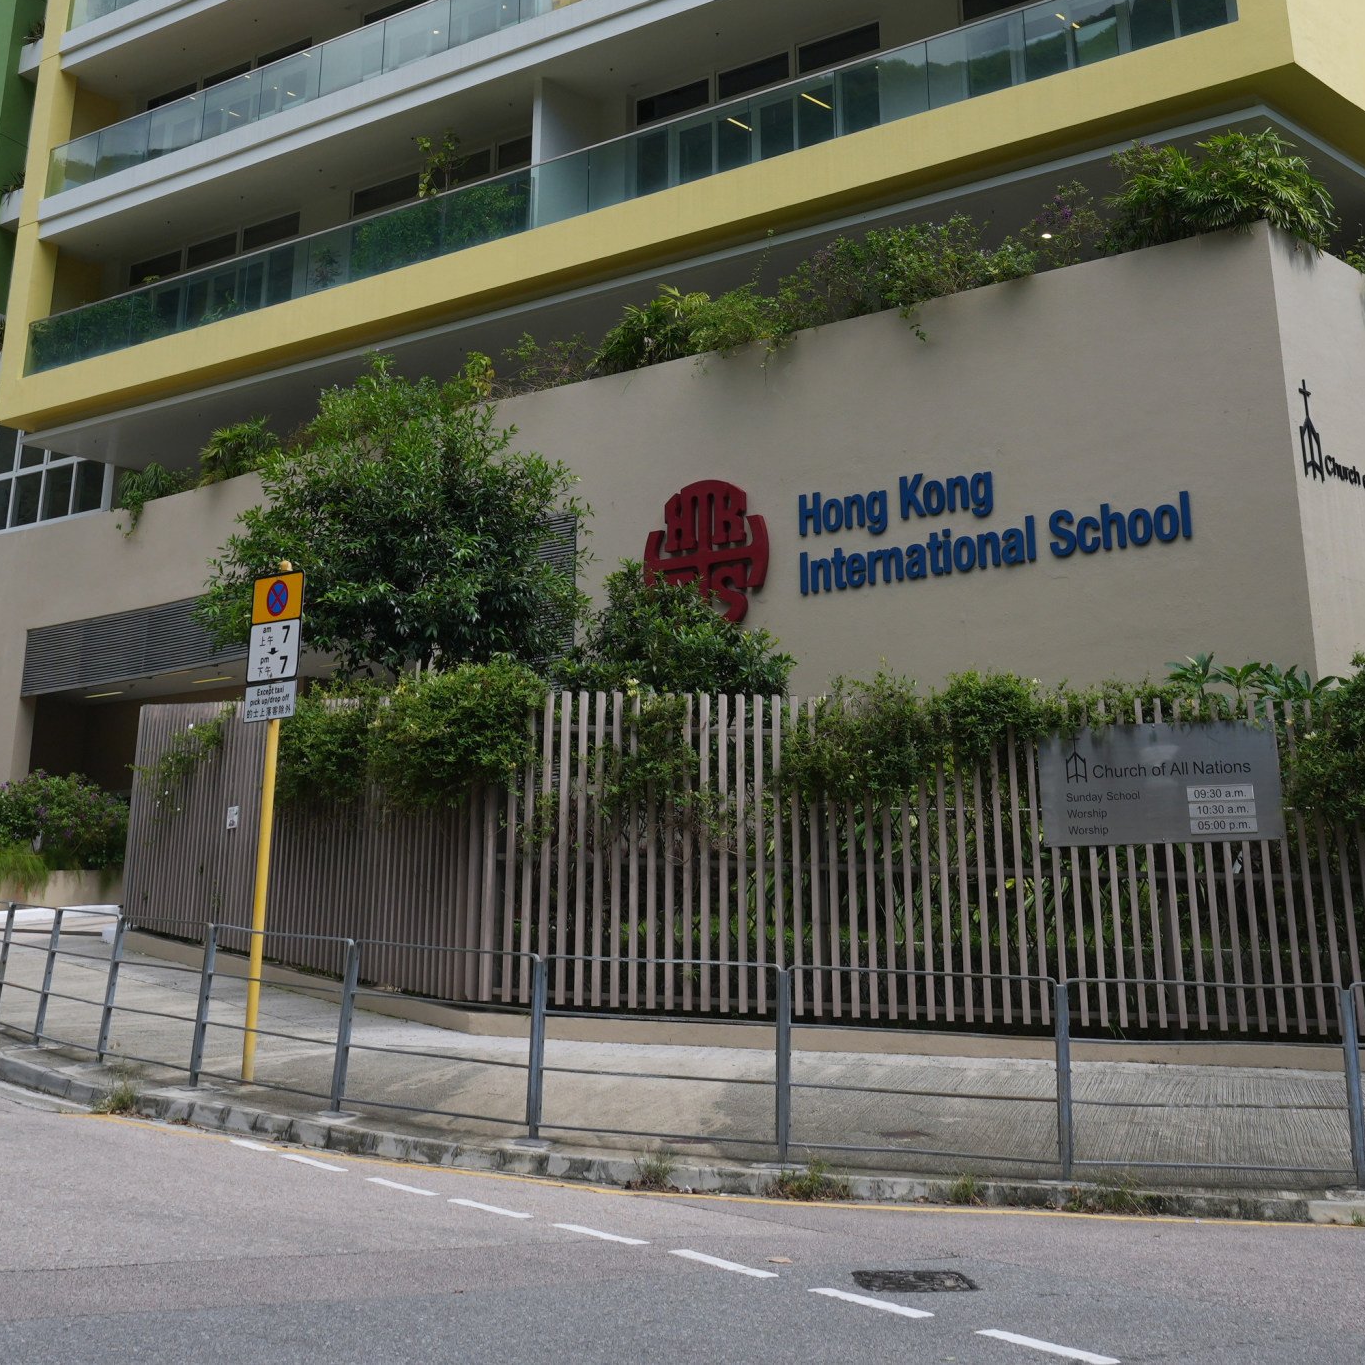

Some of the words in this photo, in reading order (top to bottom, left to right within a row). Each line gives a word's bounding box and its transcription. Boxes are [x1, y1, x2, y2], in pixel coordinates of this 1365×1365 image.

[1324, 455, 1361, 486] Church
[798, 491, 889, 537] Hong
[898, 471, 994, 520] Kong
[799, 515, 1037, 596] International
[1048, 490, 1192, 557] School
[259, 636, 273, 646] 上午
[263, 626, 272, 634] am
[282, 625, 290, 643] 7
[257, 666, 272, 677] 下午
[260, 657, 270, 665] pm
[279, 655, 288, 674] 7
[256, 687, 274, 696] Except
[275, 685, 285, 694] taxi
[250, 698, 261, 707] pick
[262, 695, 281, 705] up/drop
[282, 693, 290, 702] off
[246, 704, 291, 718] 的士上落客除外
[1092, 763, 1147, 778] Church
[1151, 762, 1166, 776] of
[1170, 761, 1189, 776] All
[1192, 760, 1252, 775] Nations
[1066, 792, 1103, 803] Sunday
[1106, 791, 1141, 801] School
[1193, 788, 1222, 799] 09:30
[1225, 789, 1247, 798] a.m.
[1067, 808, 1108, 819] Worship
[1197, 804, 1225, 815] 10:30
[1227, 805, 1249, 814] a.m.
[1068, 825, 1109, 836] Worship
[1197, 820, 1226, 831] 05:00
[1229, 820, 1251, 832] p.m.
